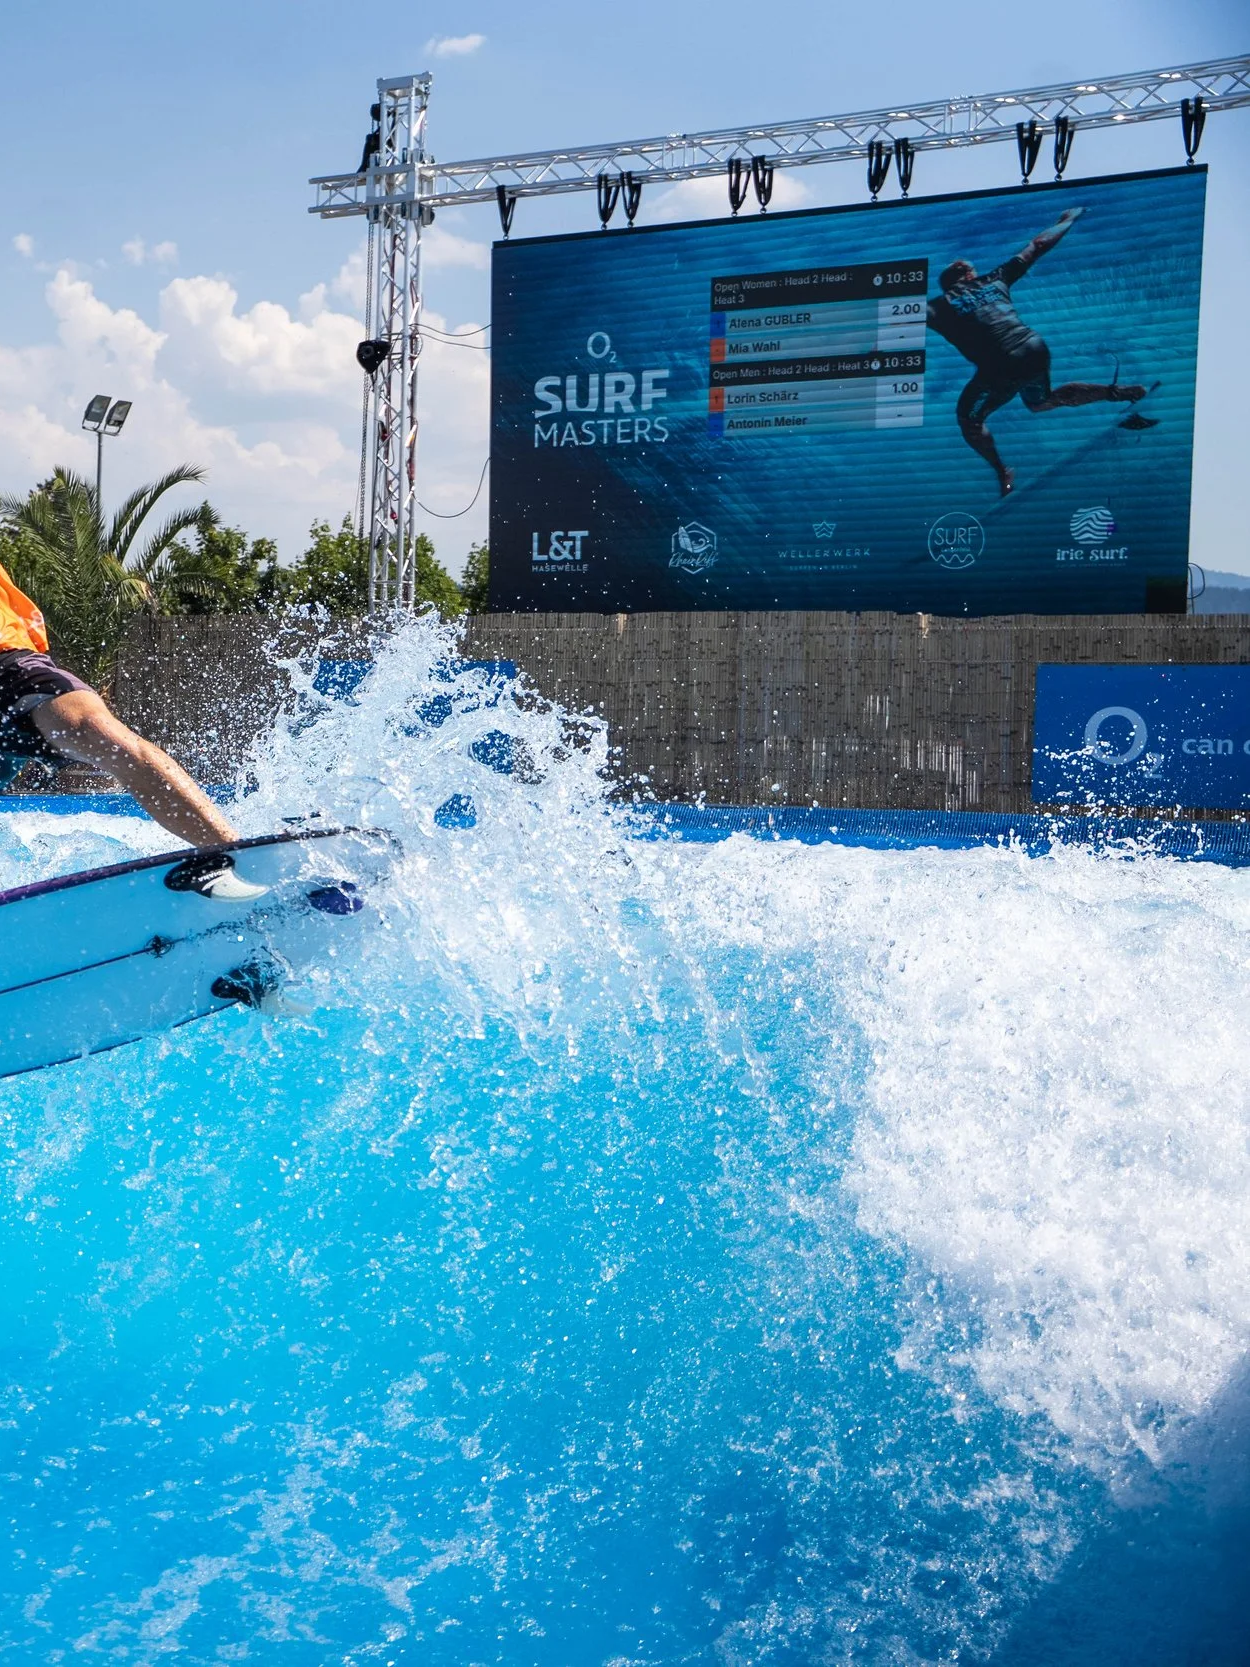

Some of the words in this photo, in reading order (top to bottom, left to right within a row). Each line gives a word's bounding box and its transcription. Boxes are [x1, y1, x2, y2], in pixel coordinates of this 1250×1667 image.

[714, 282, 739, 293] Open
[741, 279, 777, 290] Women
[784, 275, 810, 286] Head
[812, 275, 819, 284] 2
[821, 272, 847, 283] Head
[886, 270, 924, 284] 10:33
[714, 295, 736, 305] Heat
[738, 294, 745, 304] 3
[892, 303, 921, 316] 2.00
[729, 317, 762, 329] Alena
[763, 312, 812, 326] GUBLER
[728, 343, 750, 354] Mia
[751, 340, 781, 353] Wahl
[884, 355, 922, 368] 10:33
[712, 370, 738, 380] Open
[740, 367, 760, 377] Men
[768, 365, 794, 376] Head
[795, 364, 802, 374] 2
[804, 362, 830, 373] Head
[838, 361, 861, 371] Heat
[534, 369, 670, 418] SURF
[892, 381, 919, 394] 1.00
[727, 393, 756, 404] Lorin
[758, 390, 799, 403] Schärz
[727, 417, 771, 430] Antonin
[773, 415, 808, 427] Meier
[534, 416, 669, 448] MASTERS
[934, 526, 978, 545] SURF
[532, 530, 589, 562] L&T
[1055, 548, 1084, 561] irie
[532, 563, 589, 572] HASEWELLE
[1182, 738, 1234, 755] can
